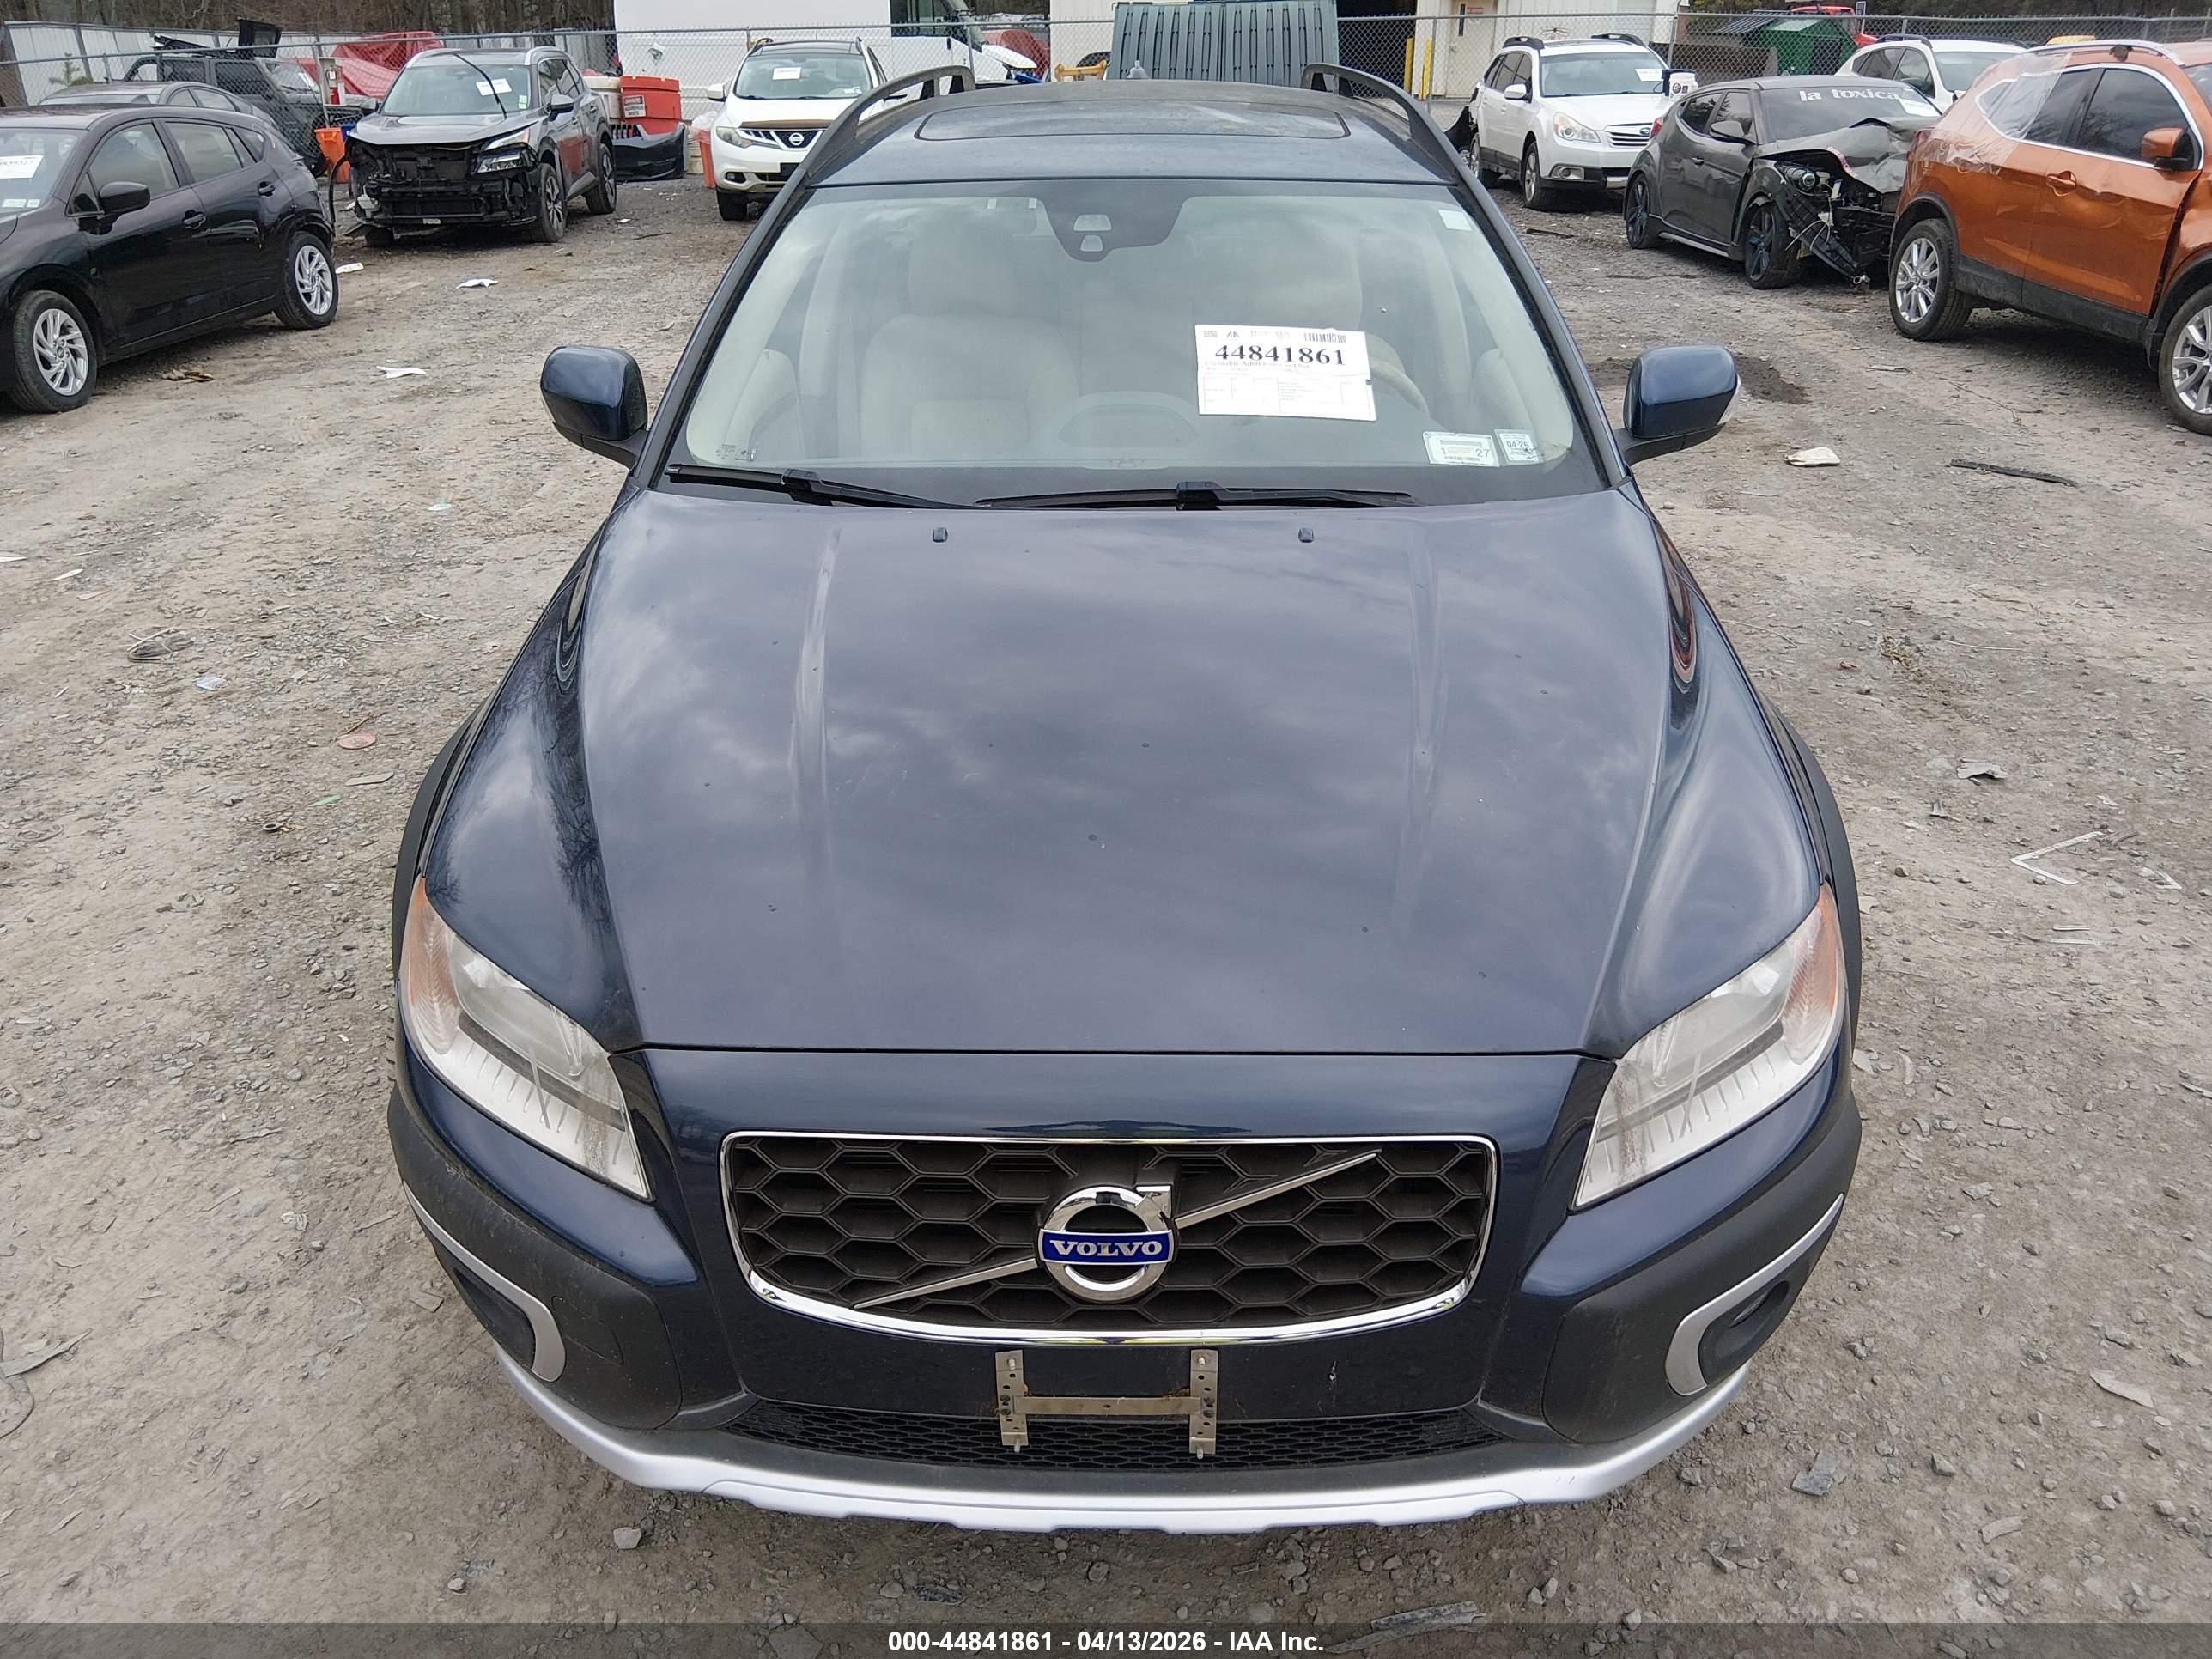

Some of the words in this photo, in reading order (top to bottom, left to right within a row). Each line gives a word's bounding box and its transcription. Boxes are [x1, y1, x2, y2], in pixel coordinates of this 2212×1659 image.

[1799, 90, 1822, 101] la
[1831, 88, 1899, 100] toxica
[1215, 344, 1346, 366] 44841861
[1475, 448, 1490, 458] 27
[1049, 1240, 1163, 1256] VOLVO
